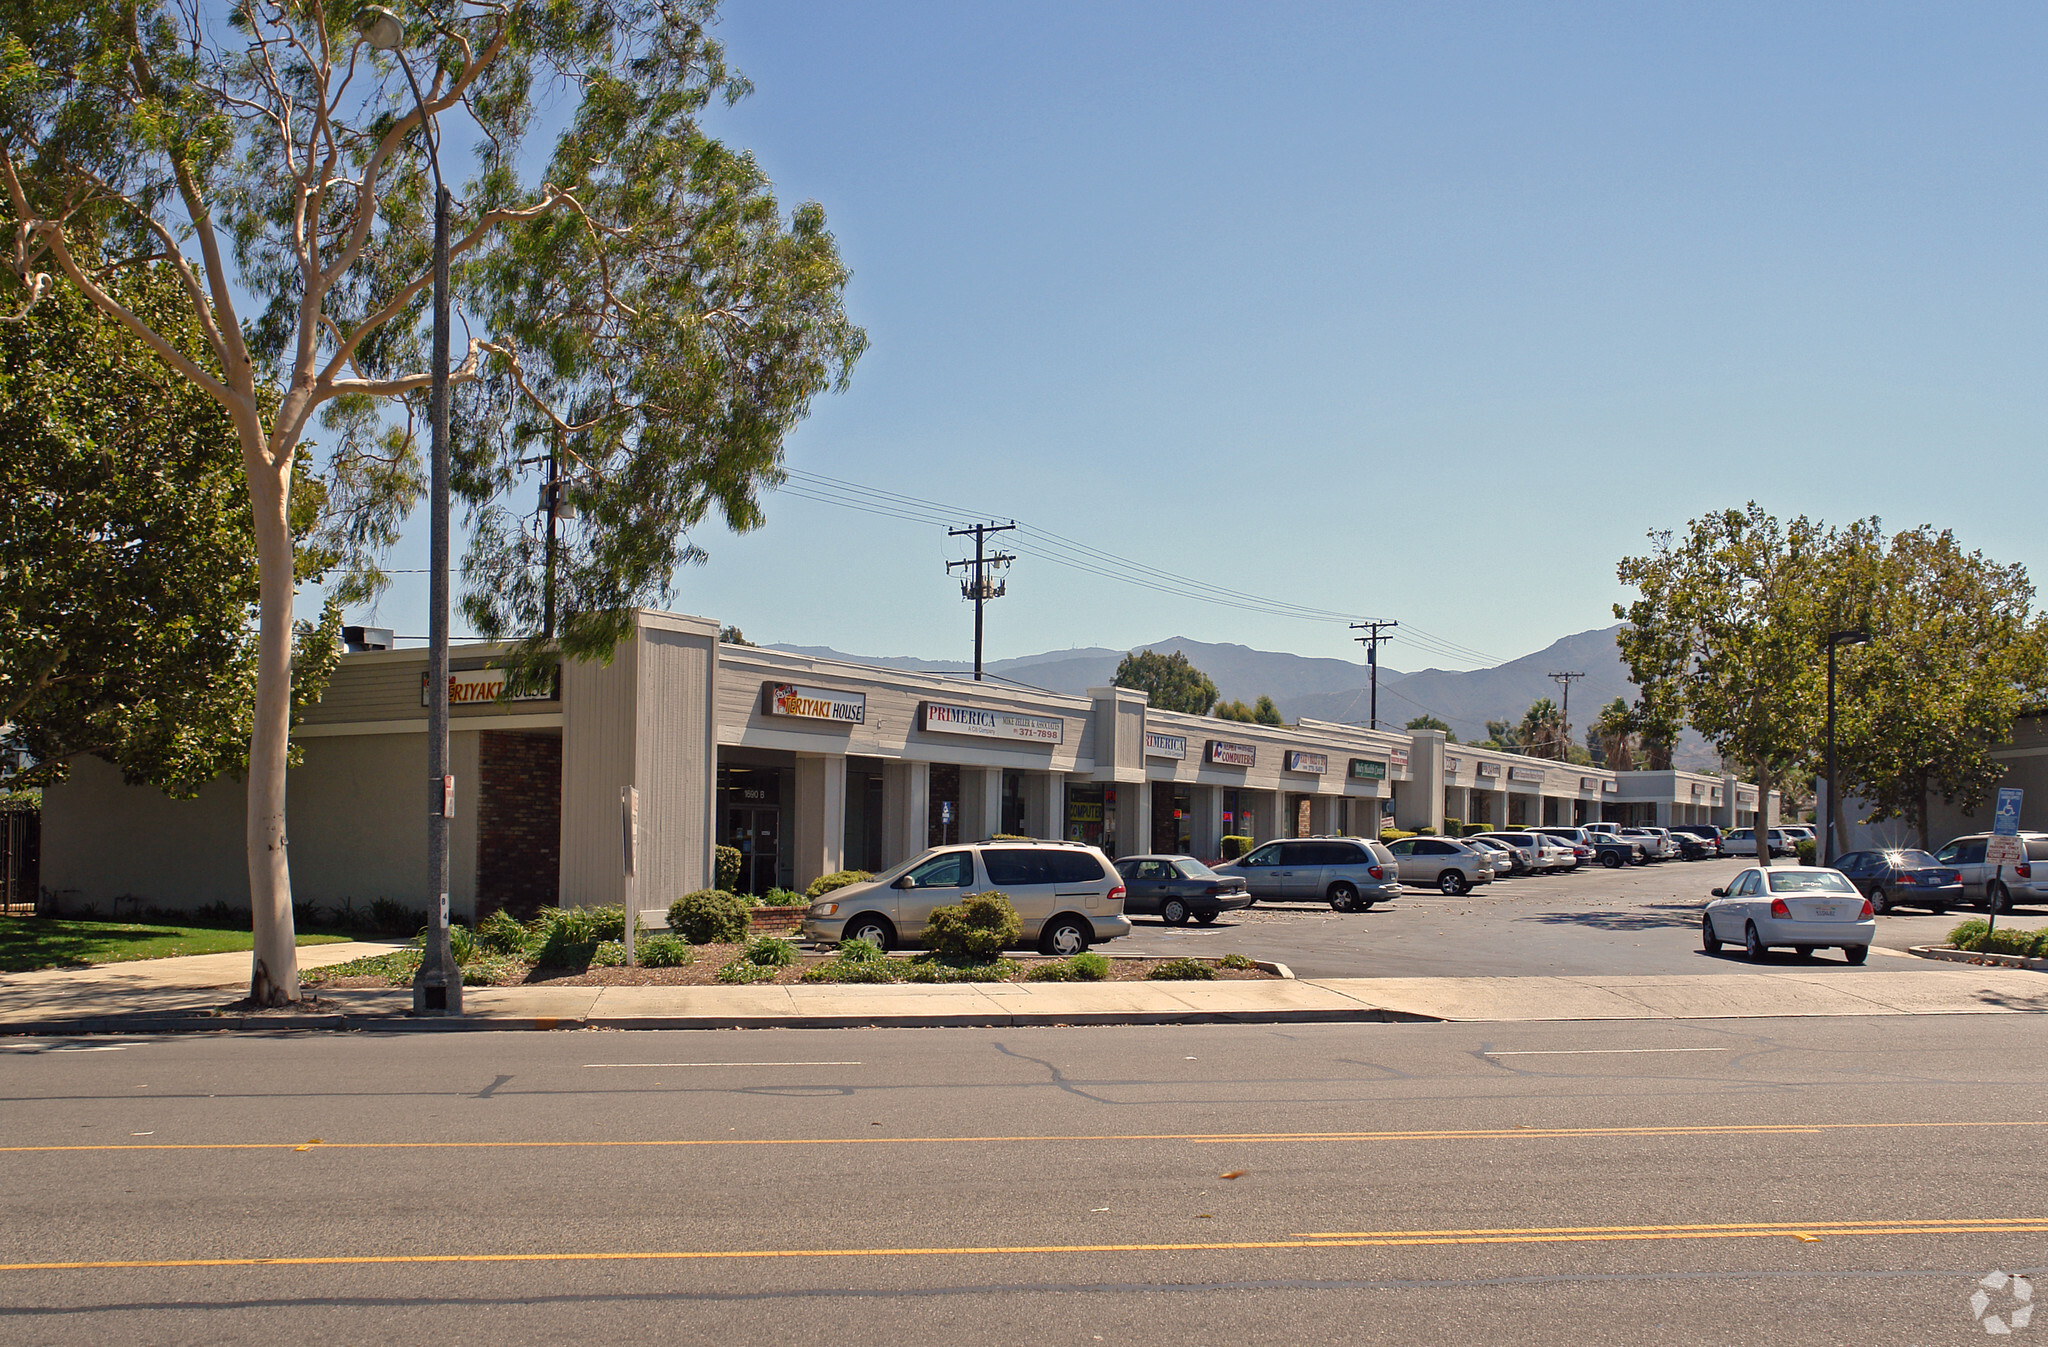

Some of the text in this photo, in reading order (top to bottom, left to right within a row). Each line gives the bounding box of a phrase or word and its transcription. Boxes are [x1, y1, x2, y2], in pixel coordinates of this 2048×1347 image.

[448, 680, 505, 702] ERIYAKI
[784, 696, 863, 721] TERIYAKI HOUSE
[929, 705, 996, 727] PRIMERICA
[1018, 728, 1058, 739] 371-7898
[1146, 734, 1184, 751] RIMERICA
[1222, 752, 1254, 766] COMPUTERS
